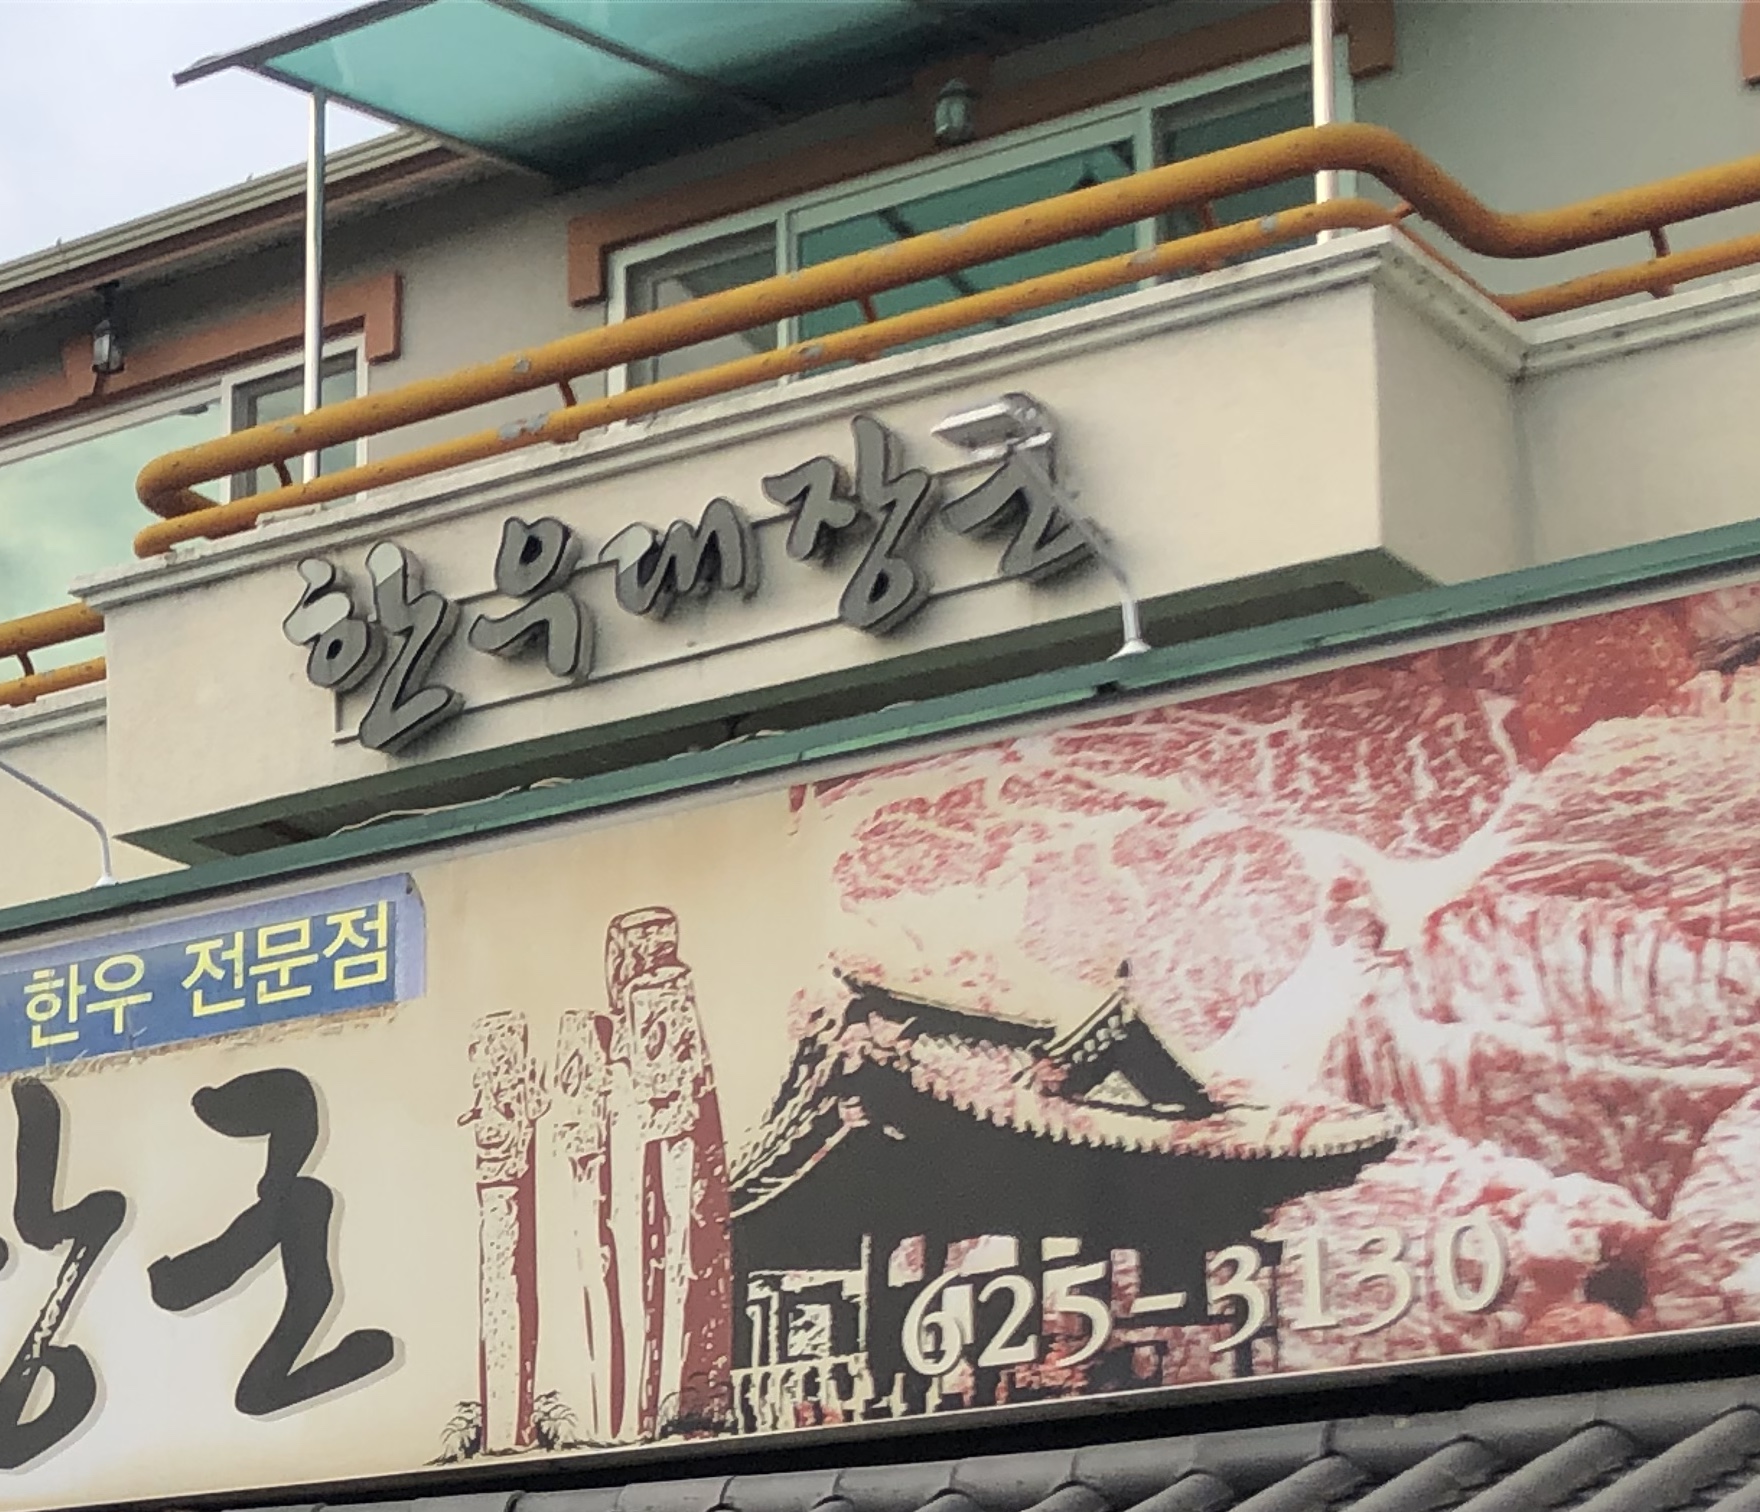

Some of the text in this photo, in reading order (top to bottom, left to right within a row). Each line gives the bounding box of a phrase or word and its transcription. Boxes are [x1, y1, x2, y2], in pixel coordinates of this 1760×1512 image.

[282, 392, 1102, 755] 한우대장군
[22, 954, 153, 1048] 한우
[182, 900, 390, 1018] 전문점
[901, 1215, 1510, 1376] 625-3130
